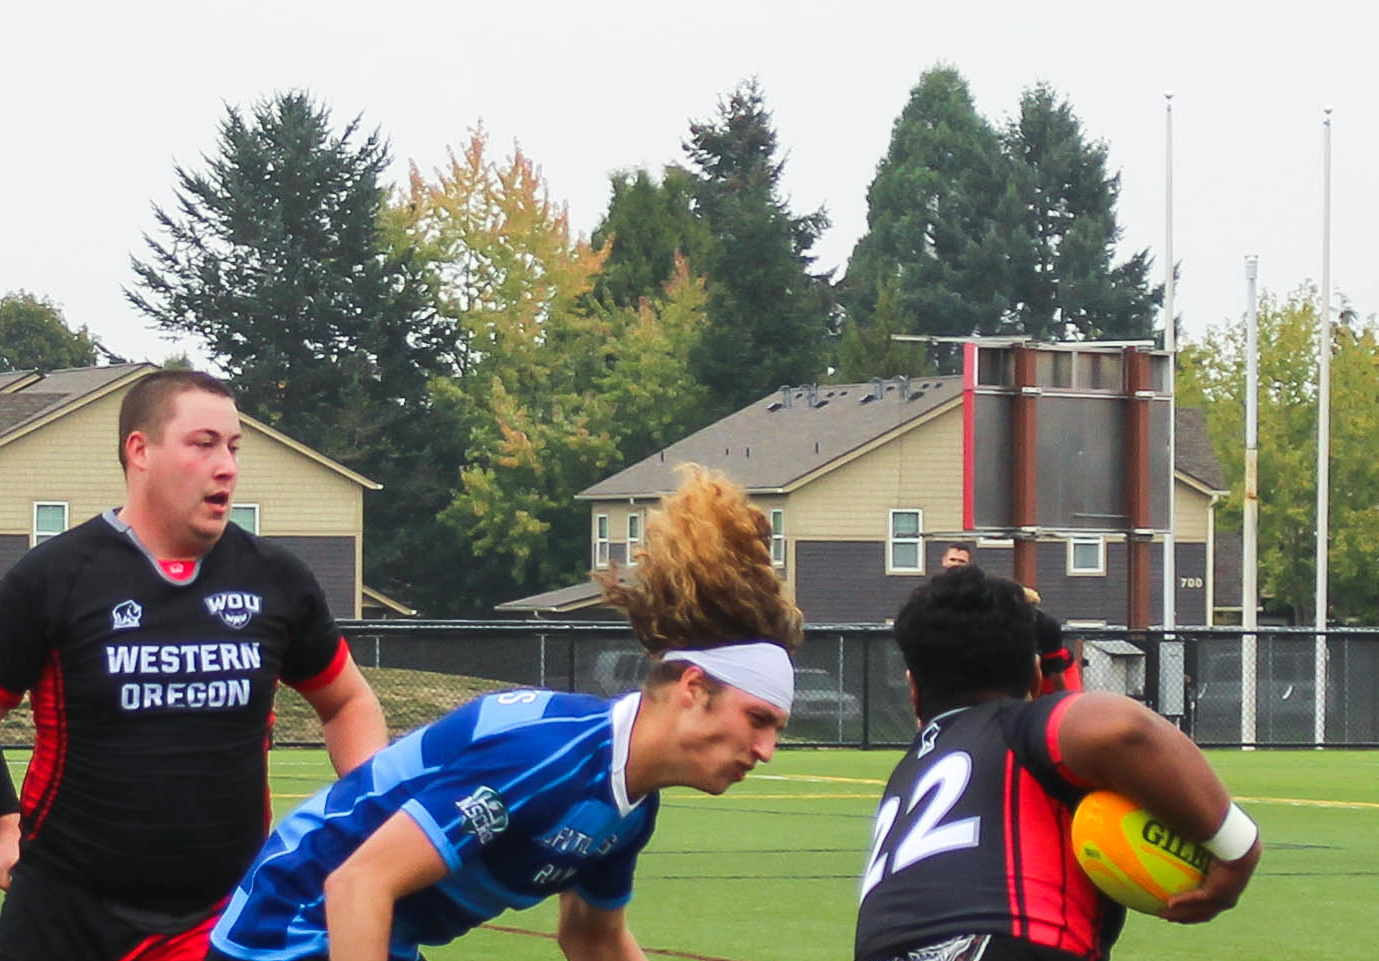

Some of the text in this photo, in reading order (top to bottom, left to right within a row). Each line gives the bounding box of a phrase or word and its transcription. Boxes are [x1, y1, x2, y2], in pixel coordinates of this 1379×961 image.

[1180, 577, 1203, 588] 700
[205, 592, 262, 614] WOU
[106, 642, 261, 674] WESTERN
[120, 679, 251, 710] OREGON
[860, 751, 981, 903] 22
